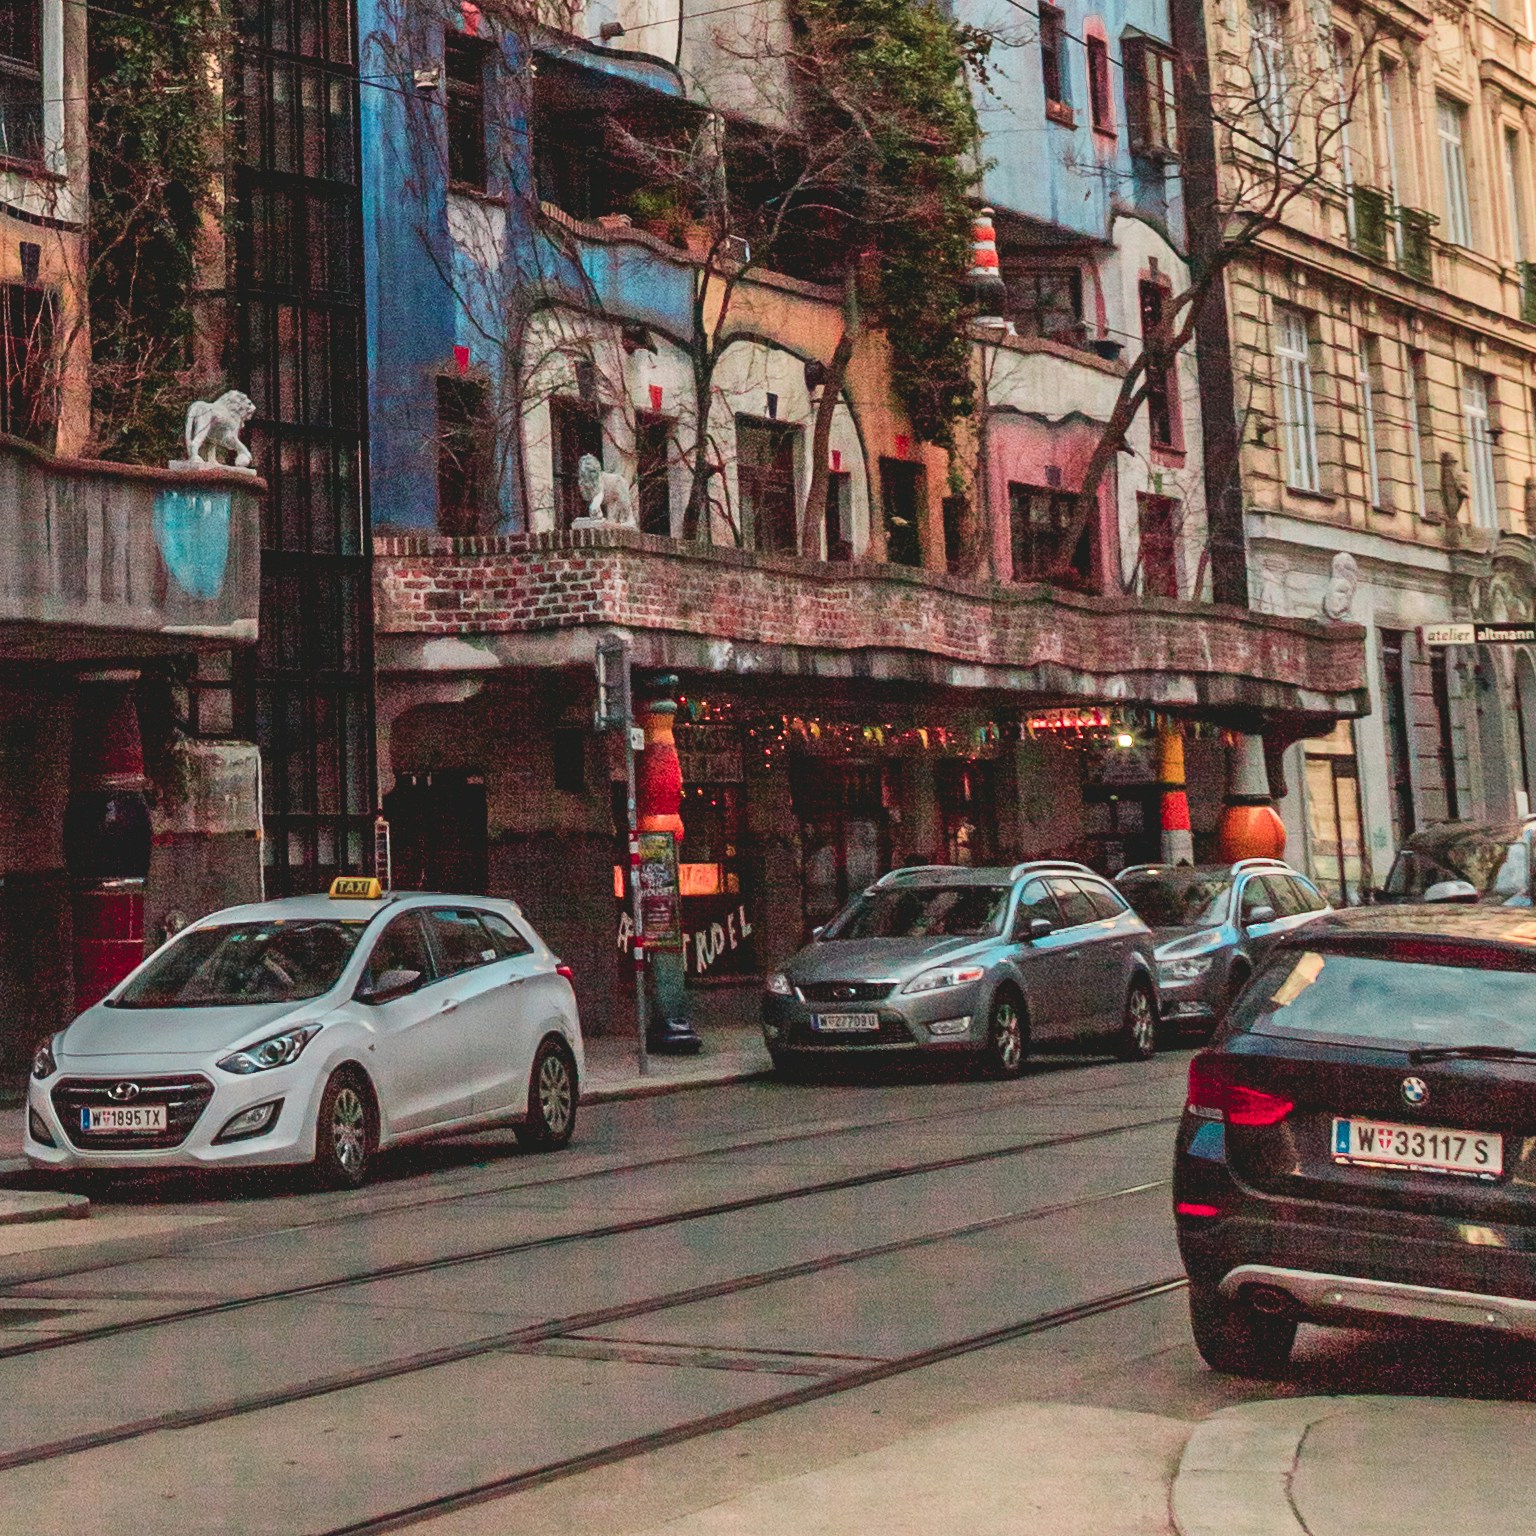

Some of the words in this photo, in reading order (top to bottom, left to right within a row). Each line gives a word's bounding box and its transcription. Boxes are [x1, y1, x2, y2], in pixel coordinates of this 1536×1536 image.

[1427, 628, 1470, 641] atelier
[1477, 628, 1534, 640] altmann
[338, 881, 369, 893] TAXI
[92, 1111, 101, 1126] W
[112, 1110, 142, 1127] 1895
[145, 1110, 161, 1126] TX
[1358, 1127, 1375, 1153] W
[1394, 1131, 1467, 1162] 33117
[1474, 1139, 1489, 1165] S
